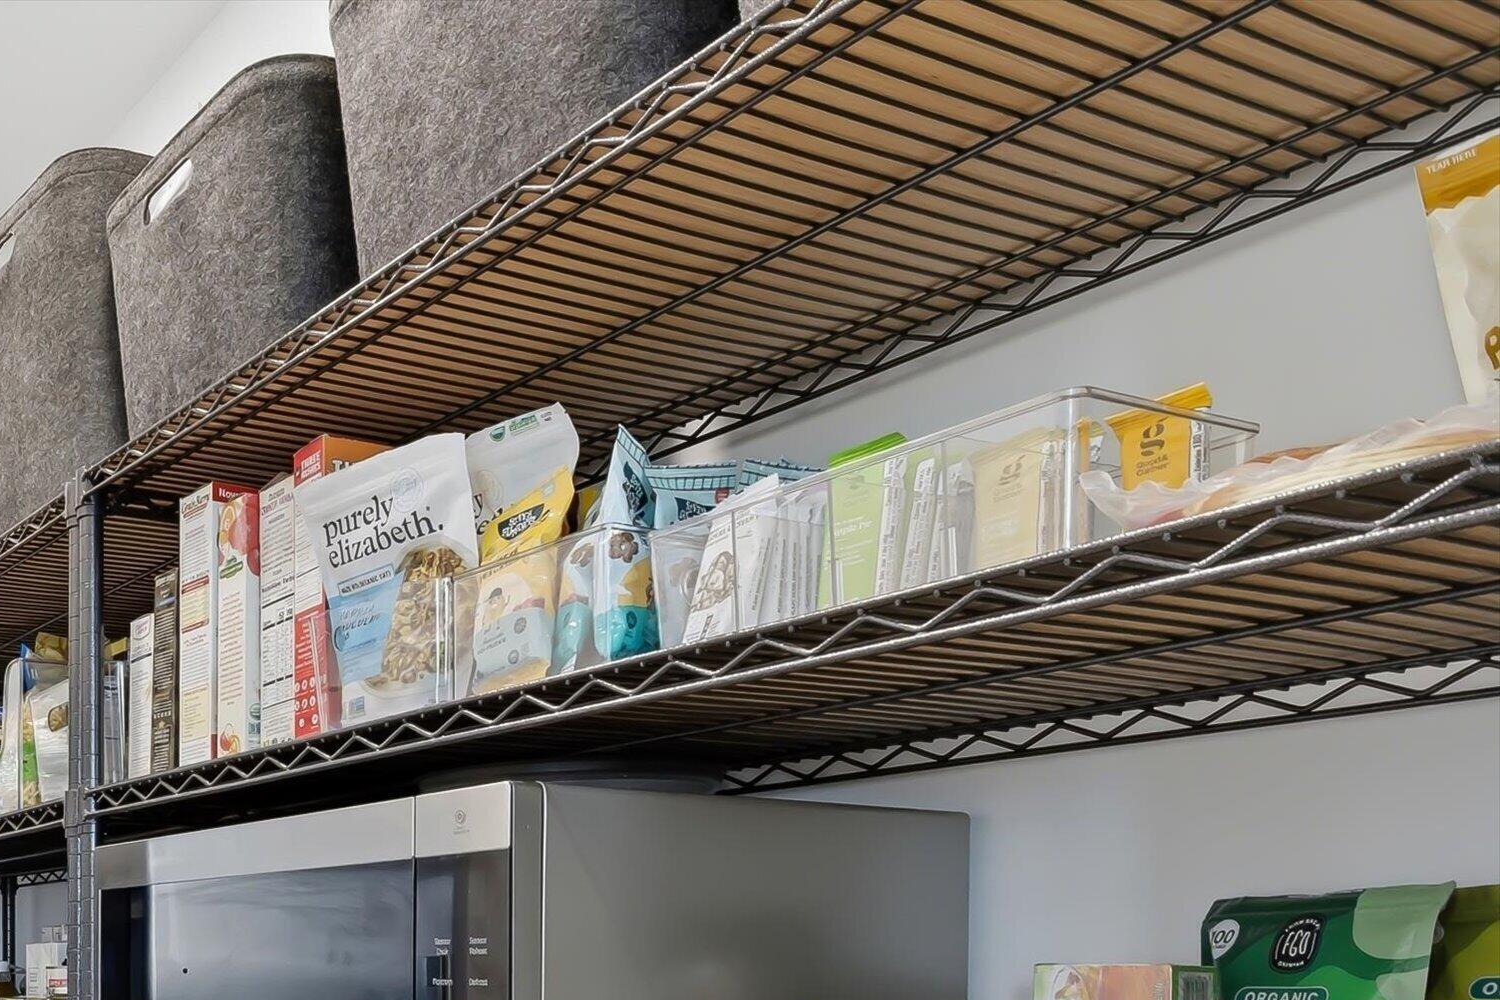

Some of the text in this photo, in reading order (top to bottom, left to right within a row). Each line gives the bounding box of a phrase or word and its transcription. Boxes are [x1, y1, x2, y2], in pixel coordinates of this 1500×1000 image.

[322, 494, 393, 548] purely
[328, 506, 444, 568] elizabeth.
[1282, 929, 1312, 957] FGO
